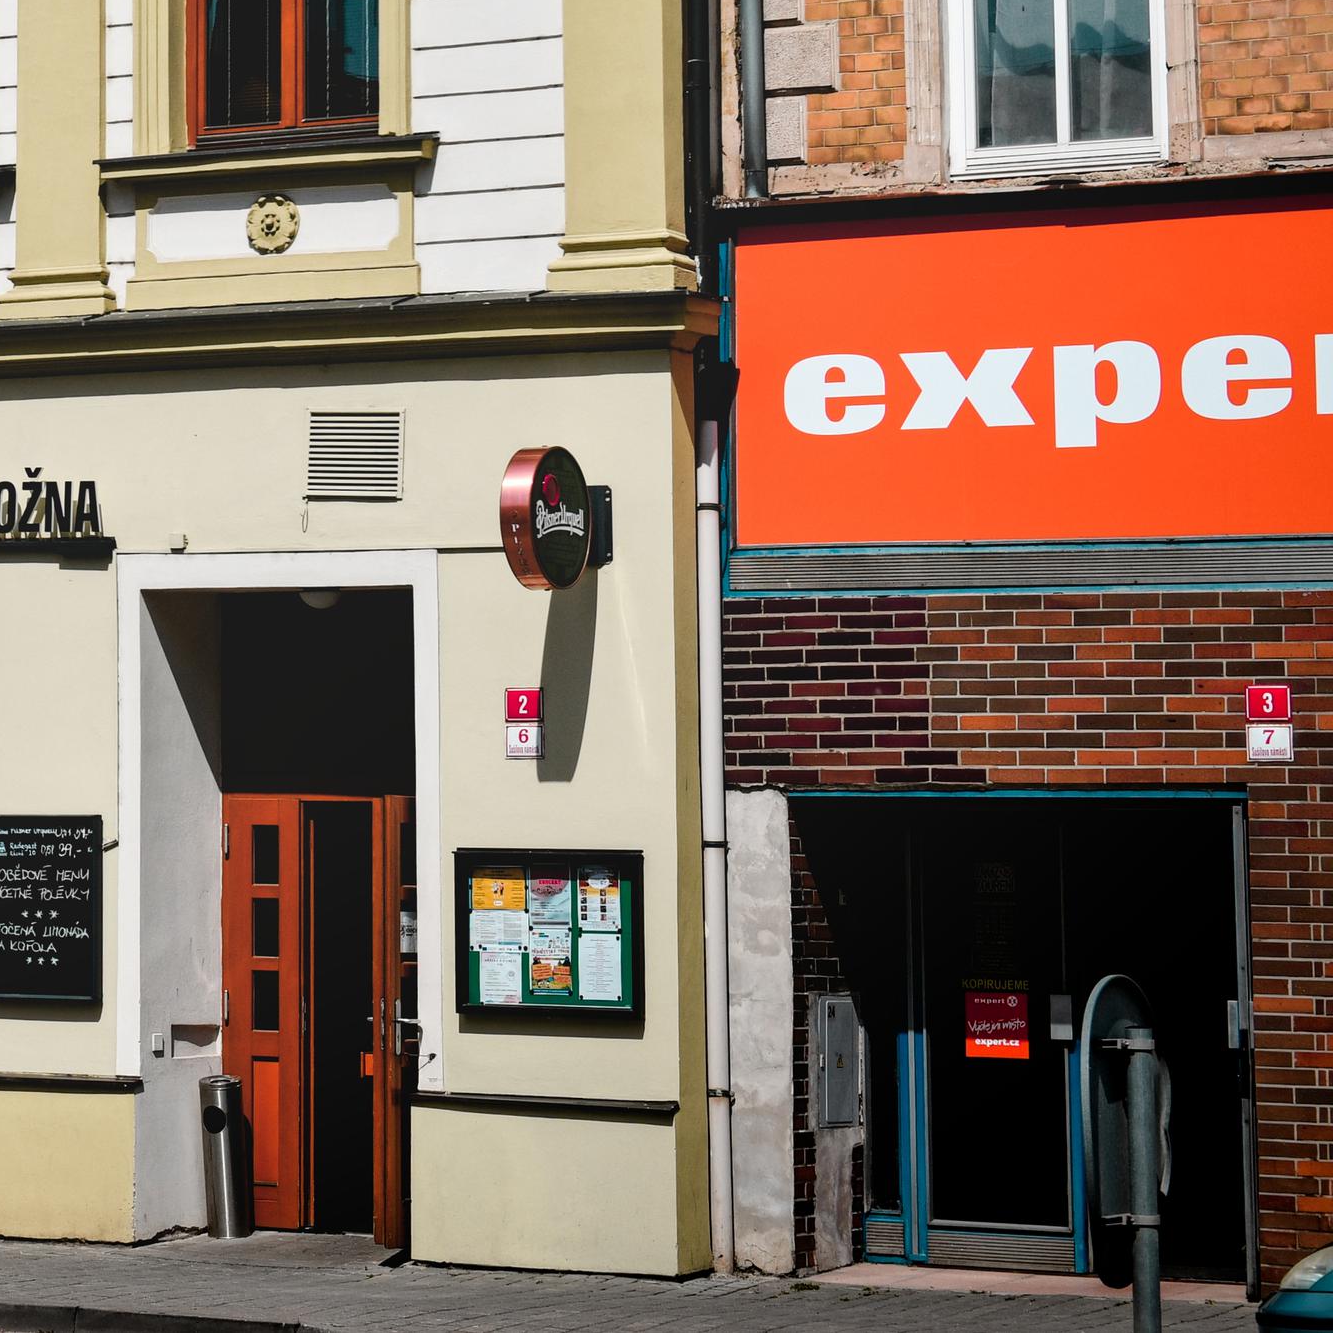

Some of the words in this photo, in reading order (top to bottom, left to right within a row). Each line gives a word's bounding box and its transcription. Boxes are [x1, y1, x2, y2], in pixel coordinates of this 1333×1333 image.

[783, 332, 1333, 449] expe
[535, 499, 561, 539] Pilsner
[559, 501, 585, 536] Urquell
[518, 694, 529, 714] 2
[1261, 691, 1274, 714] 3
[518, 728, 529, 744] 6
[1262, 729, 1275, 745] 7
[55, 868, 90, 882] MENU
[37, 885, 90, 901] POLÉVKY
[42, 920, 90, 939] LIMONÁDA
[9, 938, 58, 953] KOFOLA
[967, 1018, 1002, 1035] Výdejní
[1002, 1017, 1026, 1031] místo
[974, 1038, 1020, 1048] expert.cz
